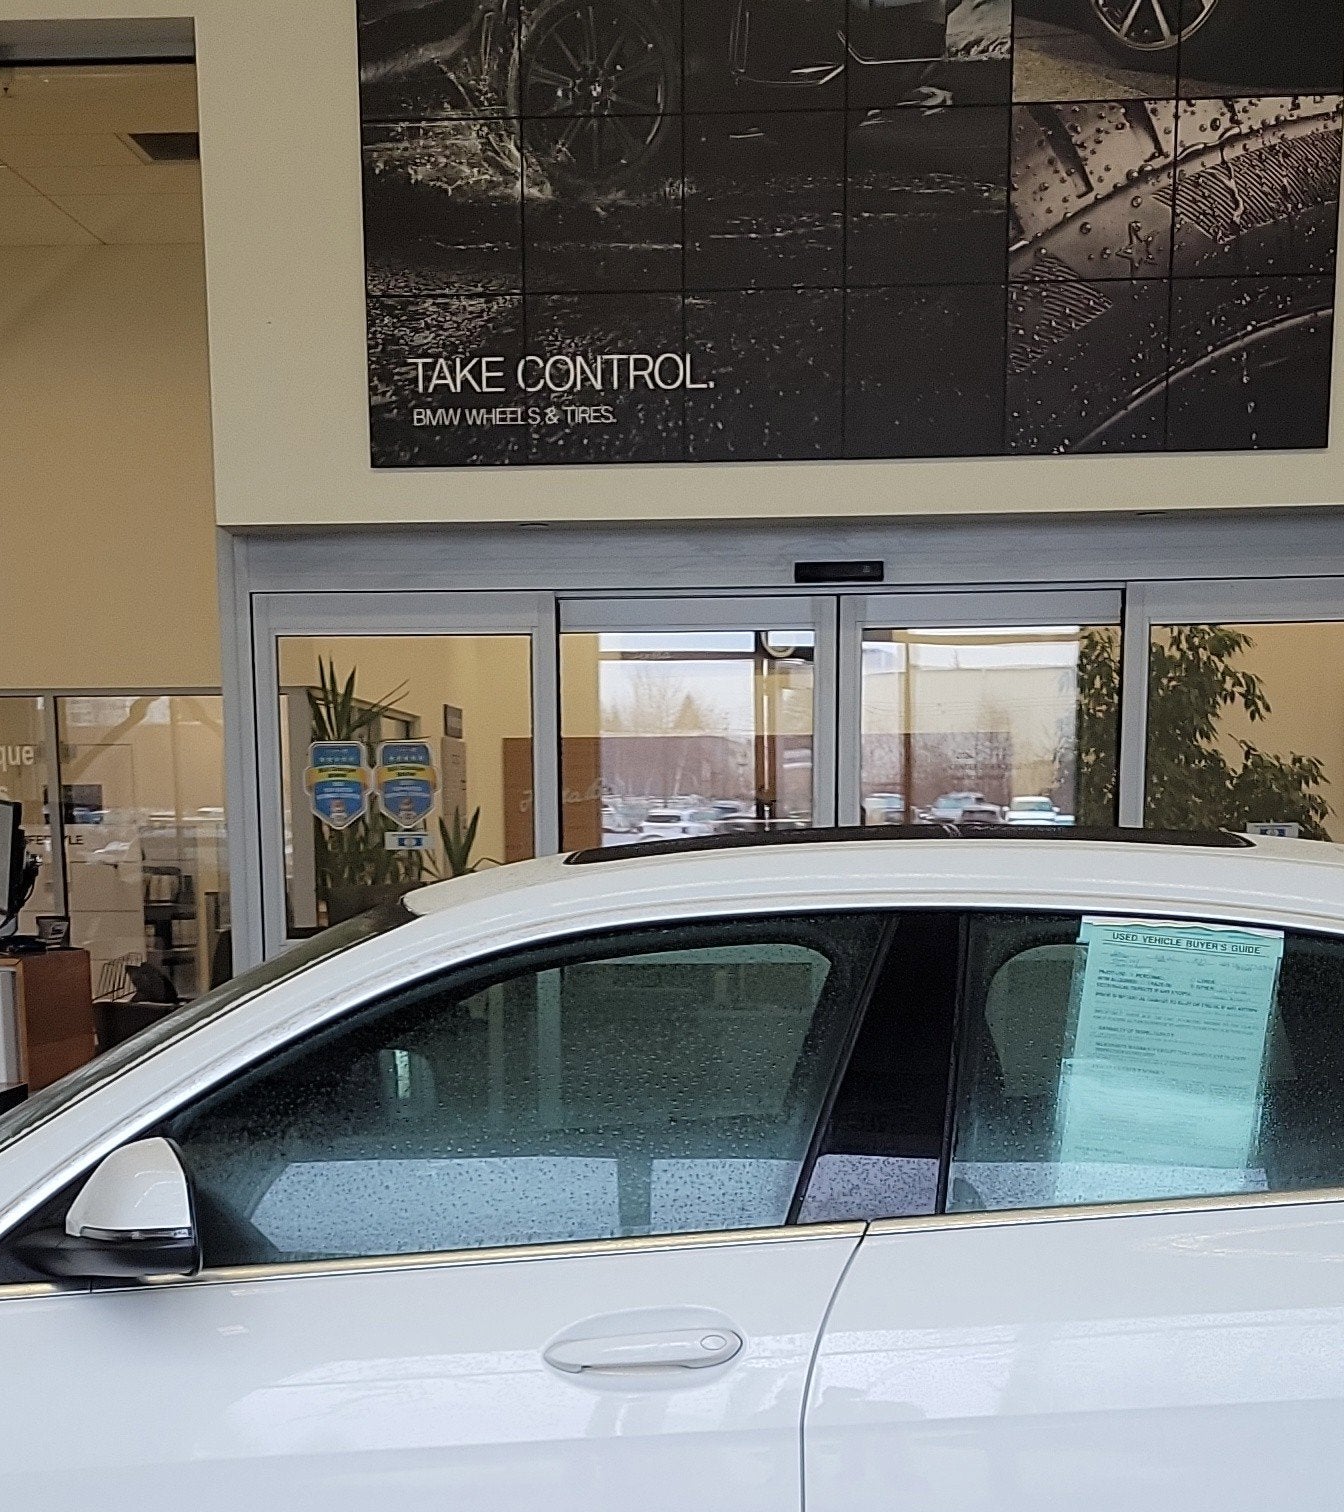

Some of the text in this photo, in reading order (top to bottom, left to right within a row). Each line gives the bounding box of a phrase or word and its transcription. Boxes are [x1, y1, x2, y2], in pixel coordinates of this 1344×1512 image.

[407, 353, 715, 393] TAKE CONTROL.
[413, 408, 461, 426] BMW
[465, 407, 540, 426] WHEELS
[544, 407, 559, 425] &
[1112, 932, 1138, 942] USED
[1142, 935, 1182, 947] VEHICLE
[1231, 944, 1261, 954] GUIDE
